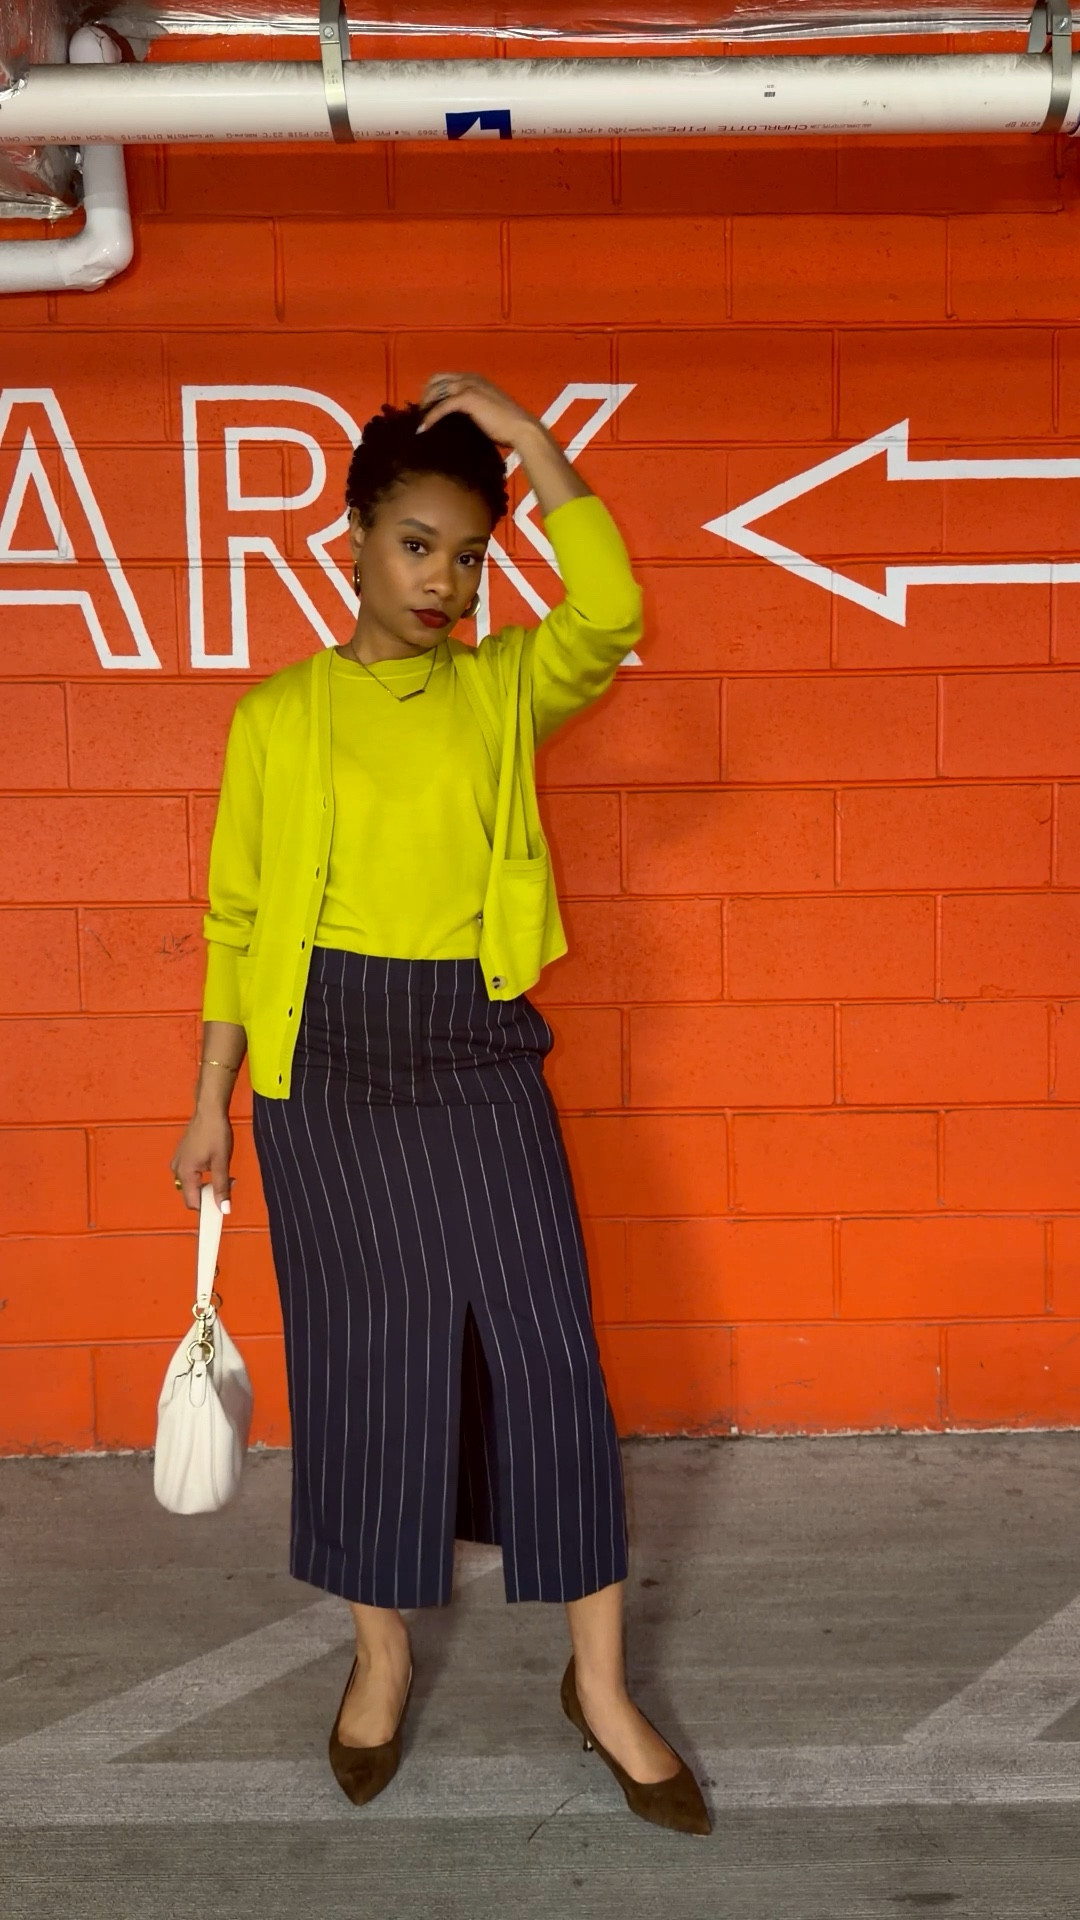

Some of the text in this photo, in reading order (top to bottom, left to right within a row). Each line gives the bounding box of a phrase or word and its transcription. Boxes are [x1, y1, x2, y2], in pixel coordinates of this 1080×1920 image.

[552, 127, 573, 135] TYPE
[717, 124, 808, 132] CHARLOTTE
[375, 130, 392, 138] PVC
